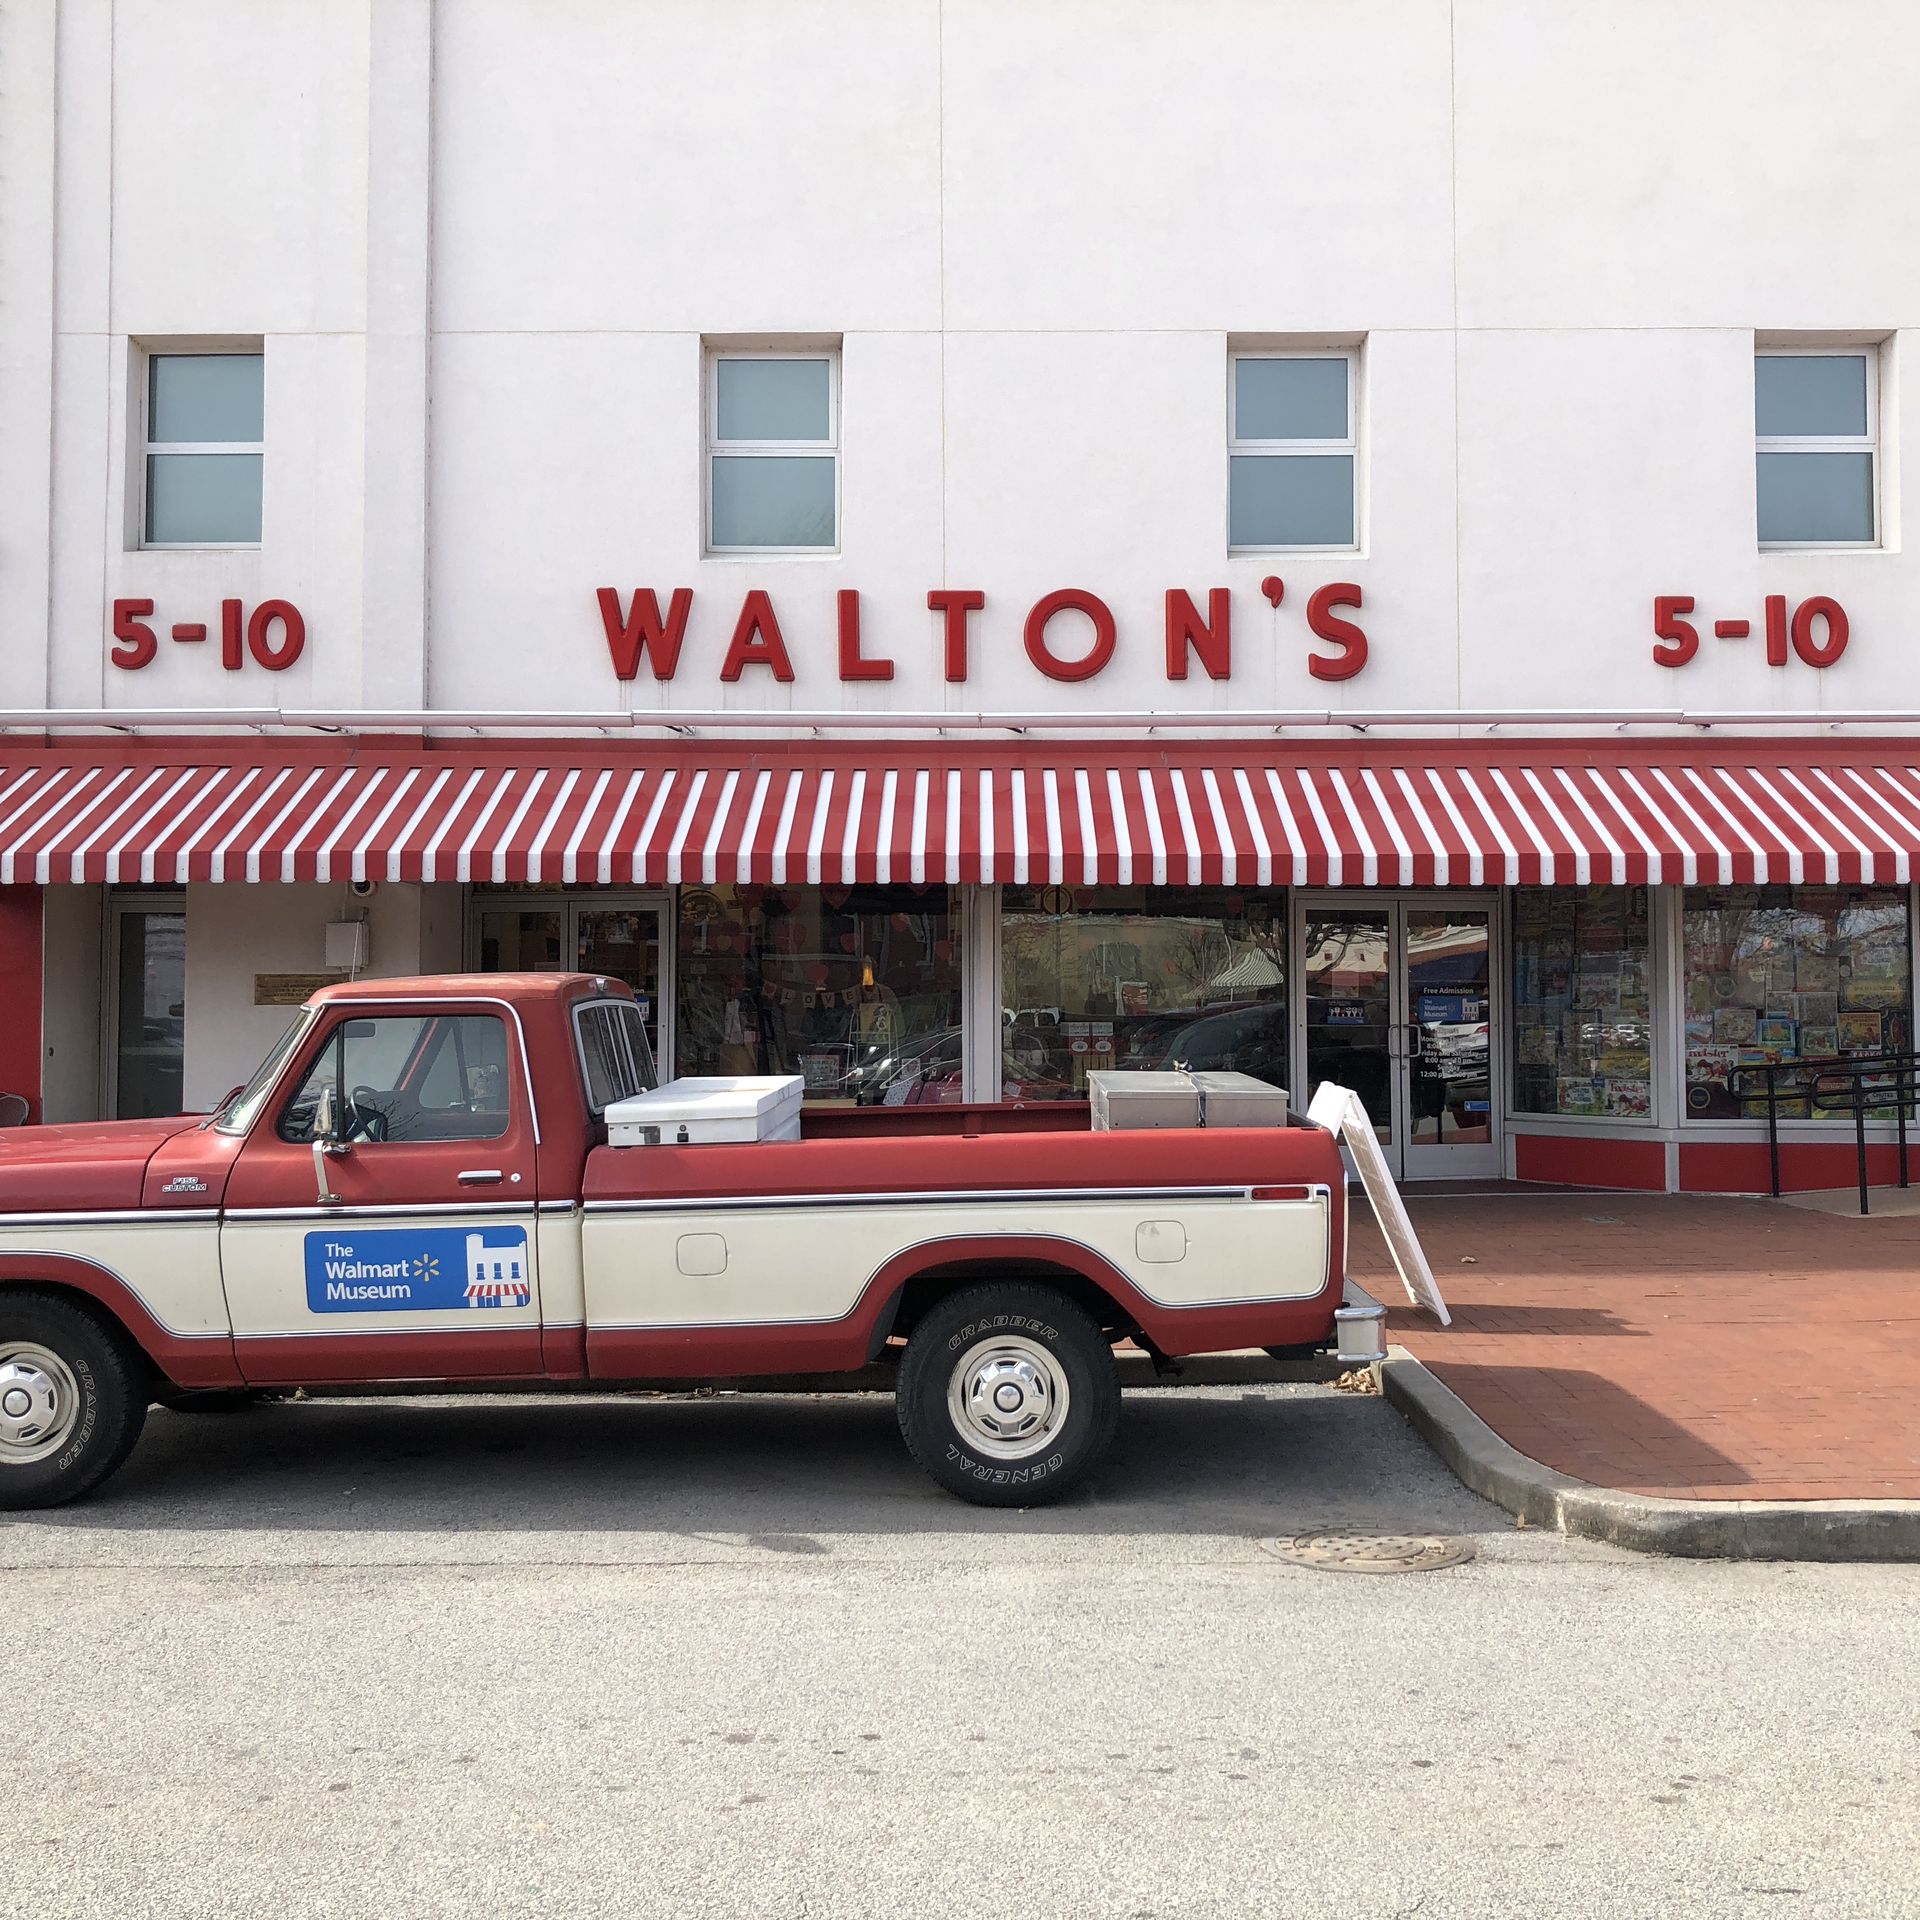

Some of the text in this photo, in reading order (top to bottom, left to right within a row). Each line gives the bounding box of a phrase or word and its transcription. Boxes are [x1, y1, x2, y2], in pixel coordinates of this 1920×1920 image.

[112, 598, 306, 671] 5-10
[596, 576, 1369, 682] WALTON'S
[1653, 594, 1850, 669] 5-10
[1421, 1049, 1438, 1057] riday
[162, 1184, 207, 1193] CUSTOM
[325, 1243, 354, 1257] The
[325, 1259, 410, 1280] Walmart
[326, 1283, 412, 1300] Museum
[948, 1315, 1059, 1351] GRABBER
[58, 1359, 97, 1470] GRABBER
[945, 1443, 1063, 1484] GENERAL
